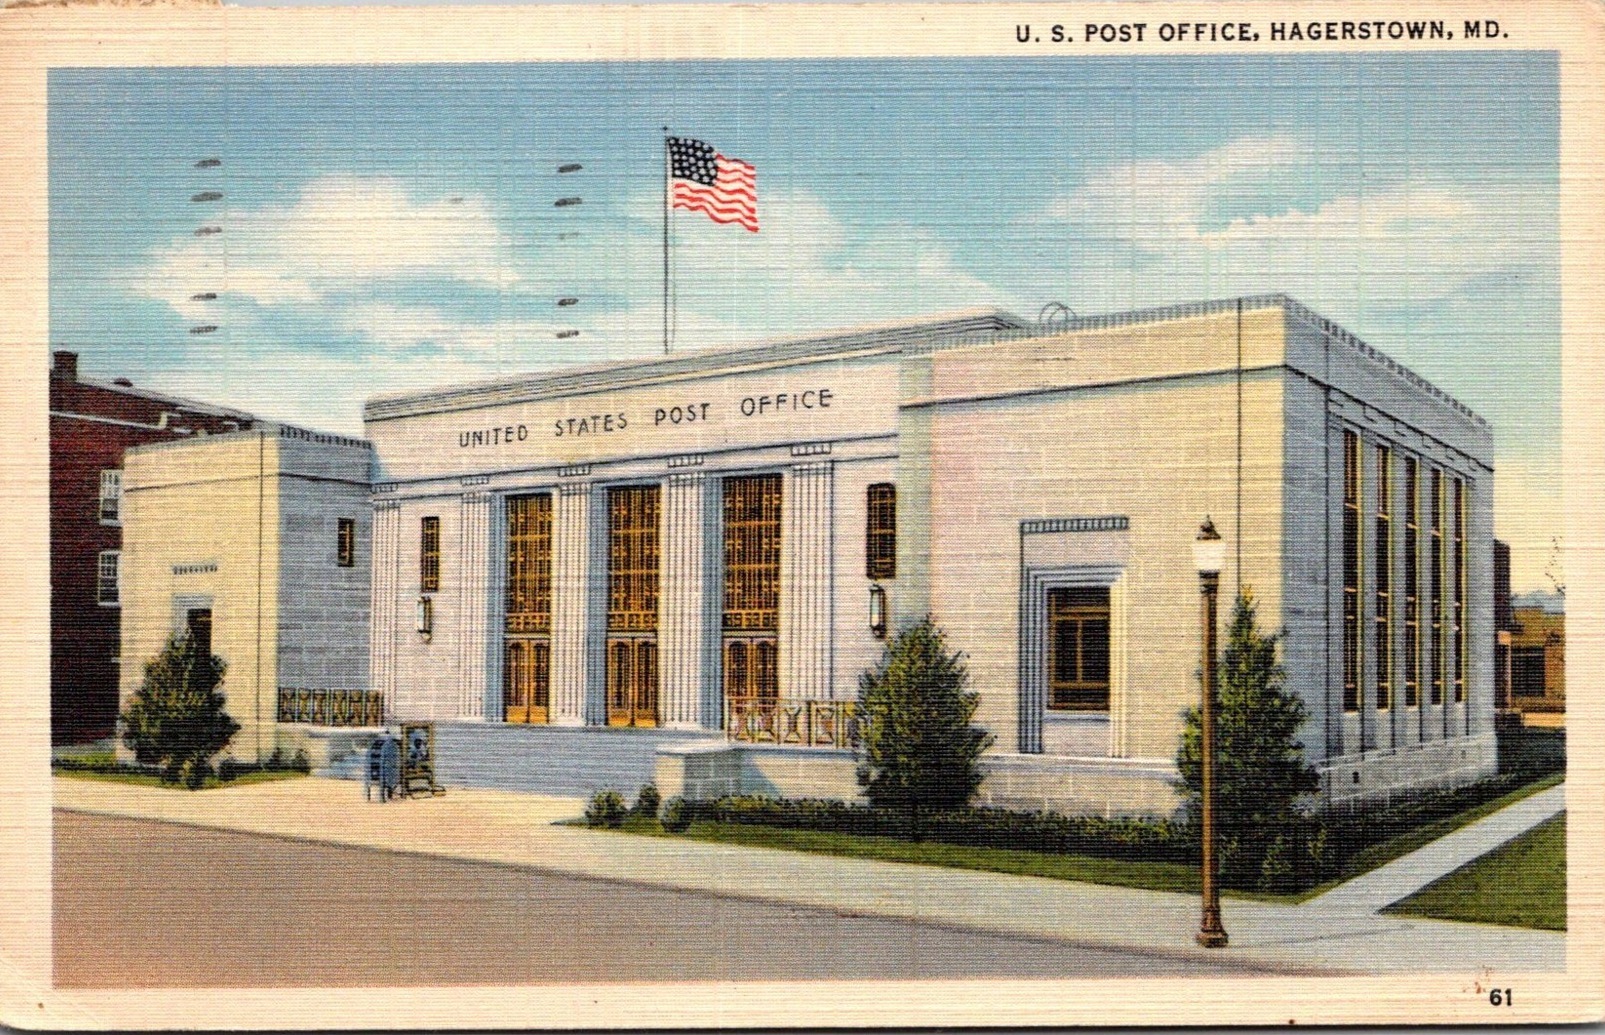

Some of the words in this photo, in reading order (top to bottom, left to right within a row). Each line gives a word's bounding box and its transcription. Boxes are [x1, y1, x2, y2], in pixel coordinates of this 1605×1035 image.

[1016, 24, 1040, 43] U.
[1051, 24, 1073, 43] S.
[1085, 23, 1147, 43] POST
[1158, 22, 1260, 42] OFFICE,
[1270, 20, 1454, 41] HAGERSTOWN,
[1464, 20, 1509, 39] MD.
[459, 424, 528, 448] UNITED
[555, 412, 628, 437] STATES
[654, 402, 710, 427] POST
[740, 388, 834, 417] OFFICE
[1489, 988, 1512, 1007] 61
